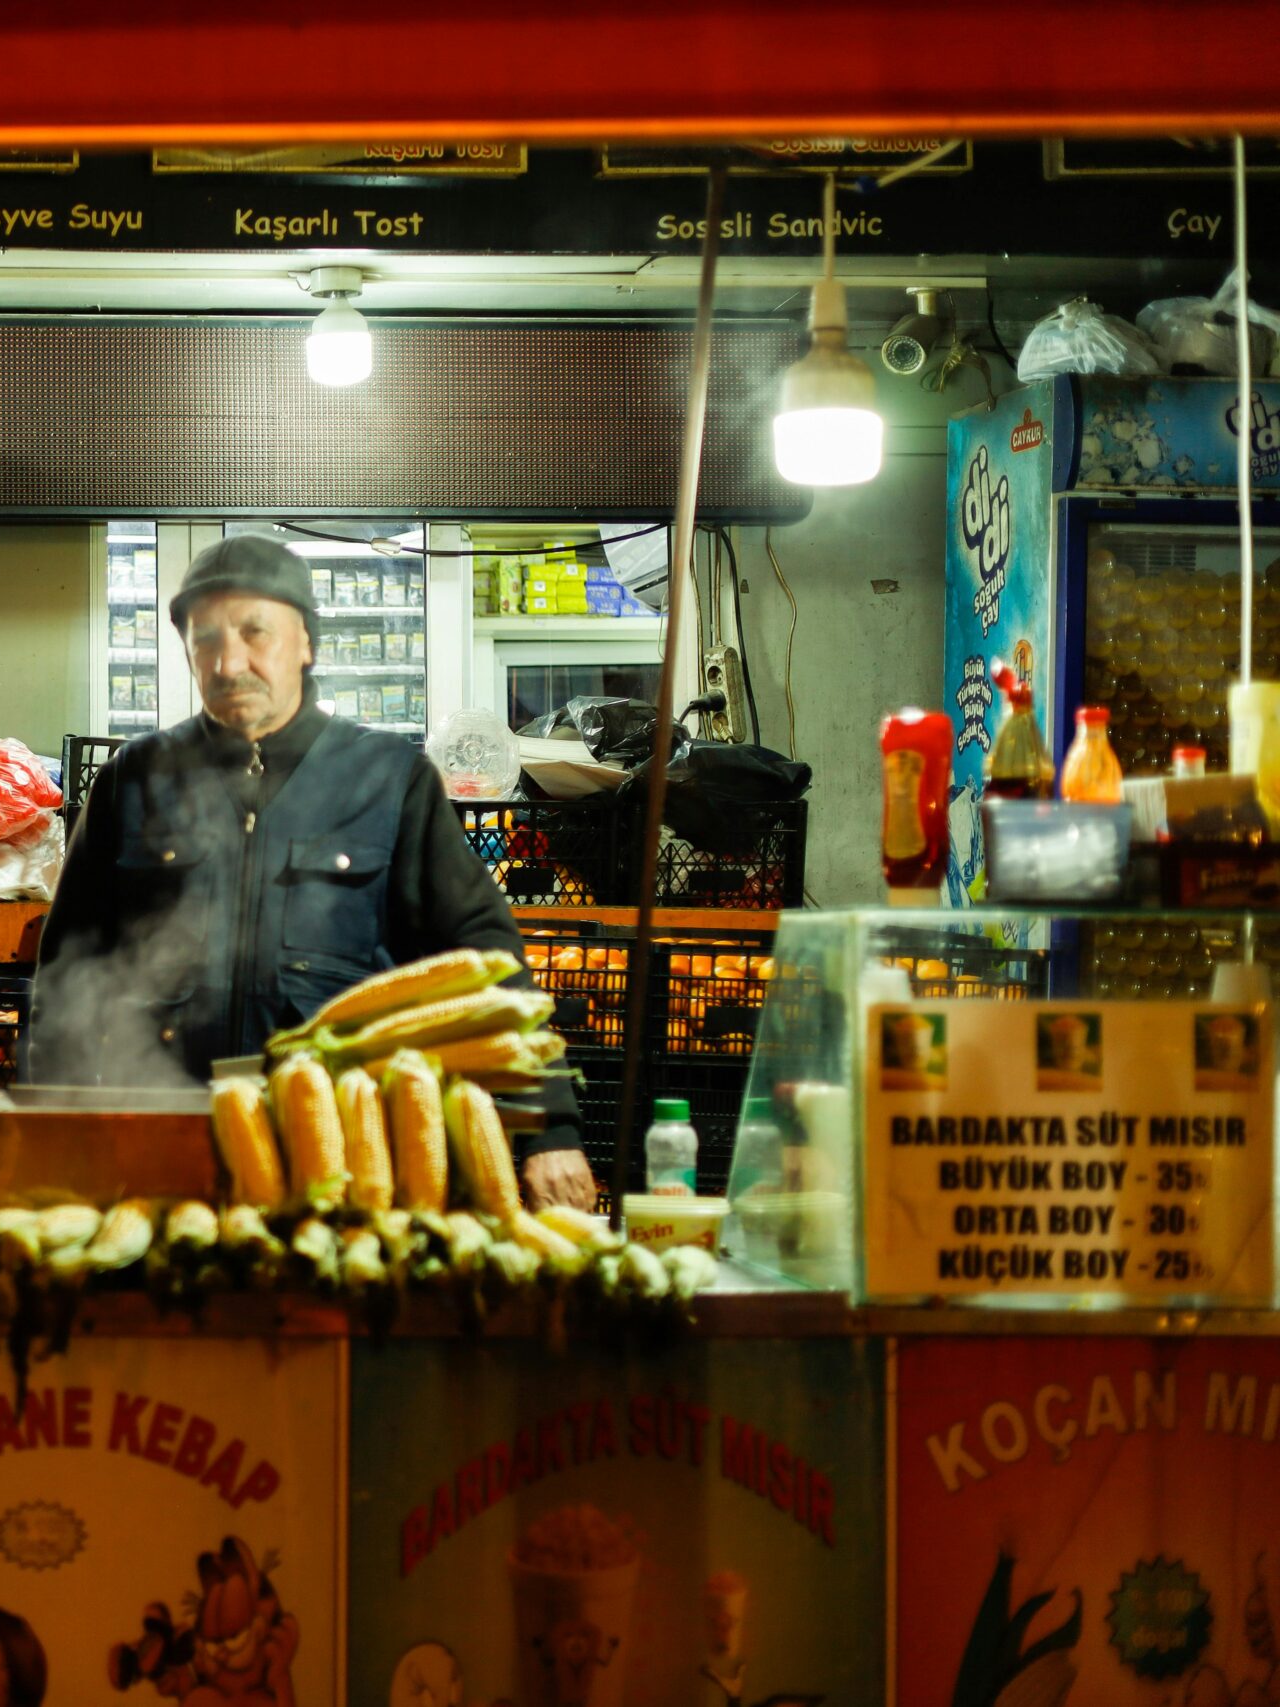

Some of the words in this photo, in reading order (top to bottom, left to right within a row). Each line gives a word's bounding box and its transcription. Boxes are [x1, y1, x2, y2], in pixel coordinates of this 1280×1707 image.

[69, 203, 142, 237] Suyu
[235, 208, 338, 241] Kaşarlı
[353, 210, 424, 236] Tost
[656, 210, 752, 240] Sossli
[1167, 207, 1222, 240] Çay
[964, 658, 985, 680] Büyük
[964, 699, 985, 720] Büyük
[890, 1115, 1067, 1146] BARDAKTA
[1075, 1112, 1140, 1146] SÜT
[1149, 1115, 1246, 1146] MISIR
[939, 1156, 1053, 1191] BÜYÜK
[1062, 1160, 1128, 1191] BOY
[953, 1204, 1039, 1235] ORTA
[1048, 1204, 1115, 1235] BOY
[938, 1245, 1054, 1284] KÜÇÜK
[1063, 1249, 1130, 1280] BOY
[925, 1369, 1177, 1492] KOÇAN
[107, 1391, 281, 1509] KEBAP
[399, 1398, 620, 1579] BARDAKTA
[628, 1385, 711, 1467] SÜT
[721, 1414, 838, 1548] MISIR
